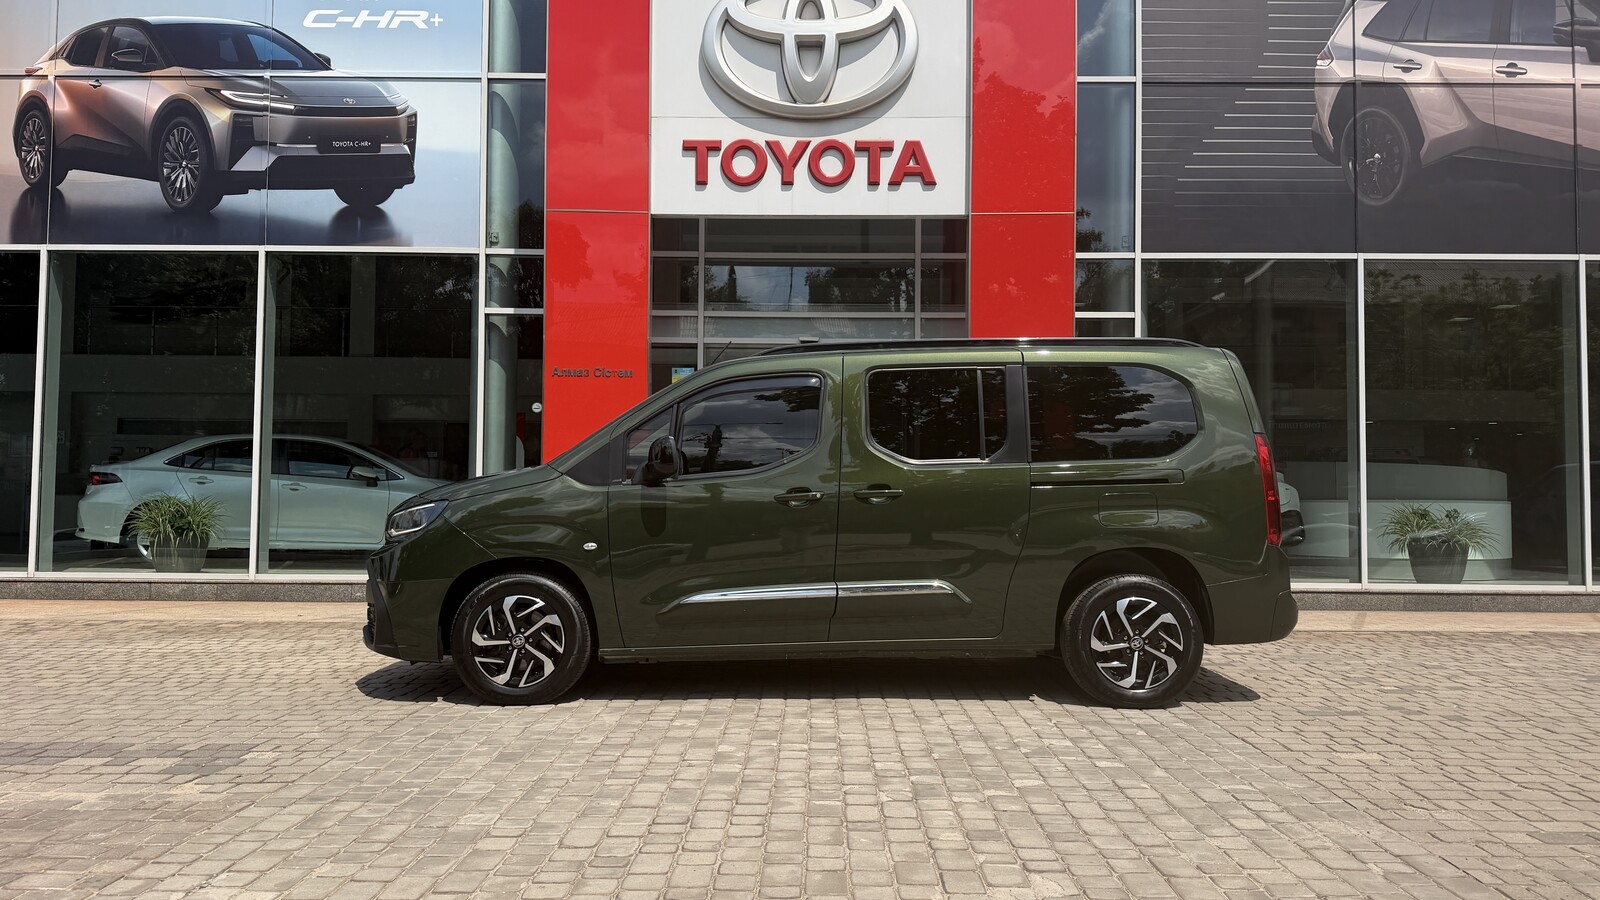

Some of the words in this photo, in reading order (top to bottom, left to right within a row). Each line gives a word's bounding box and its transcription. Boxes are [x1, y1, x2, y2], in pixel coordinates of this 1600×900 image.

[303, 9, 443, 29] C-HR+
[682, 139, 937, 187] TOYOTA
[552, 367, 590, 378] Алмаз
[593, 368, 633, 379] Сістем
